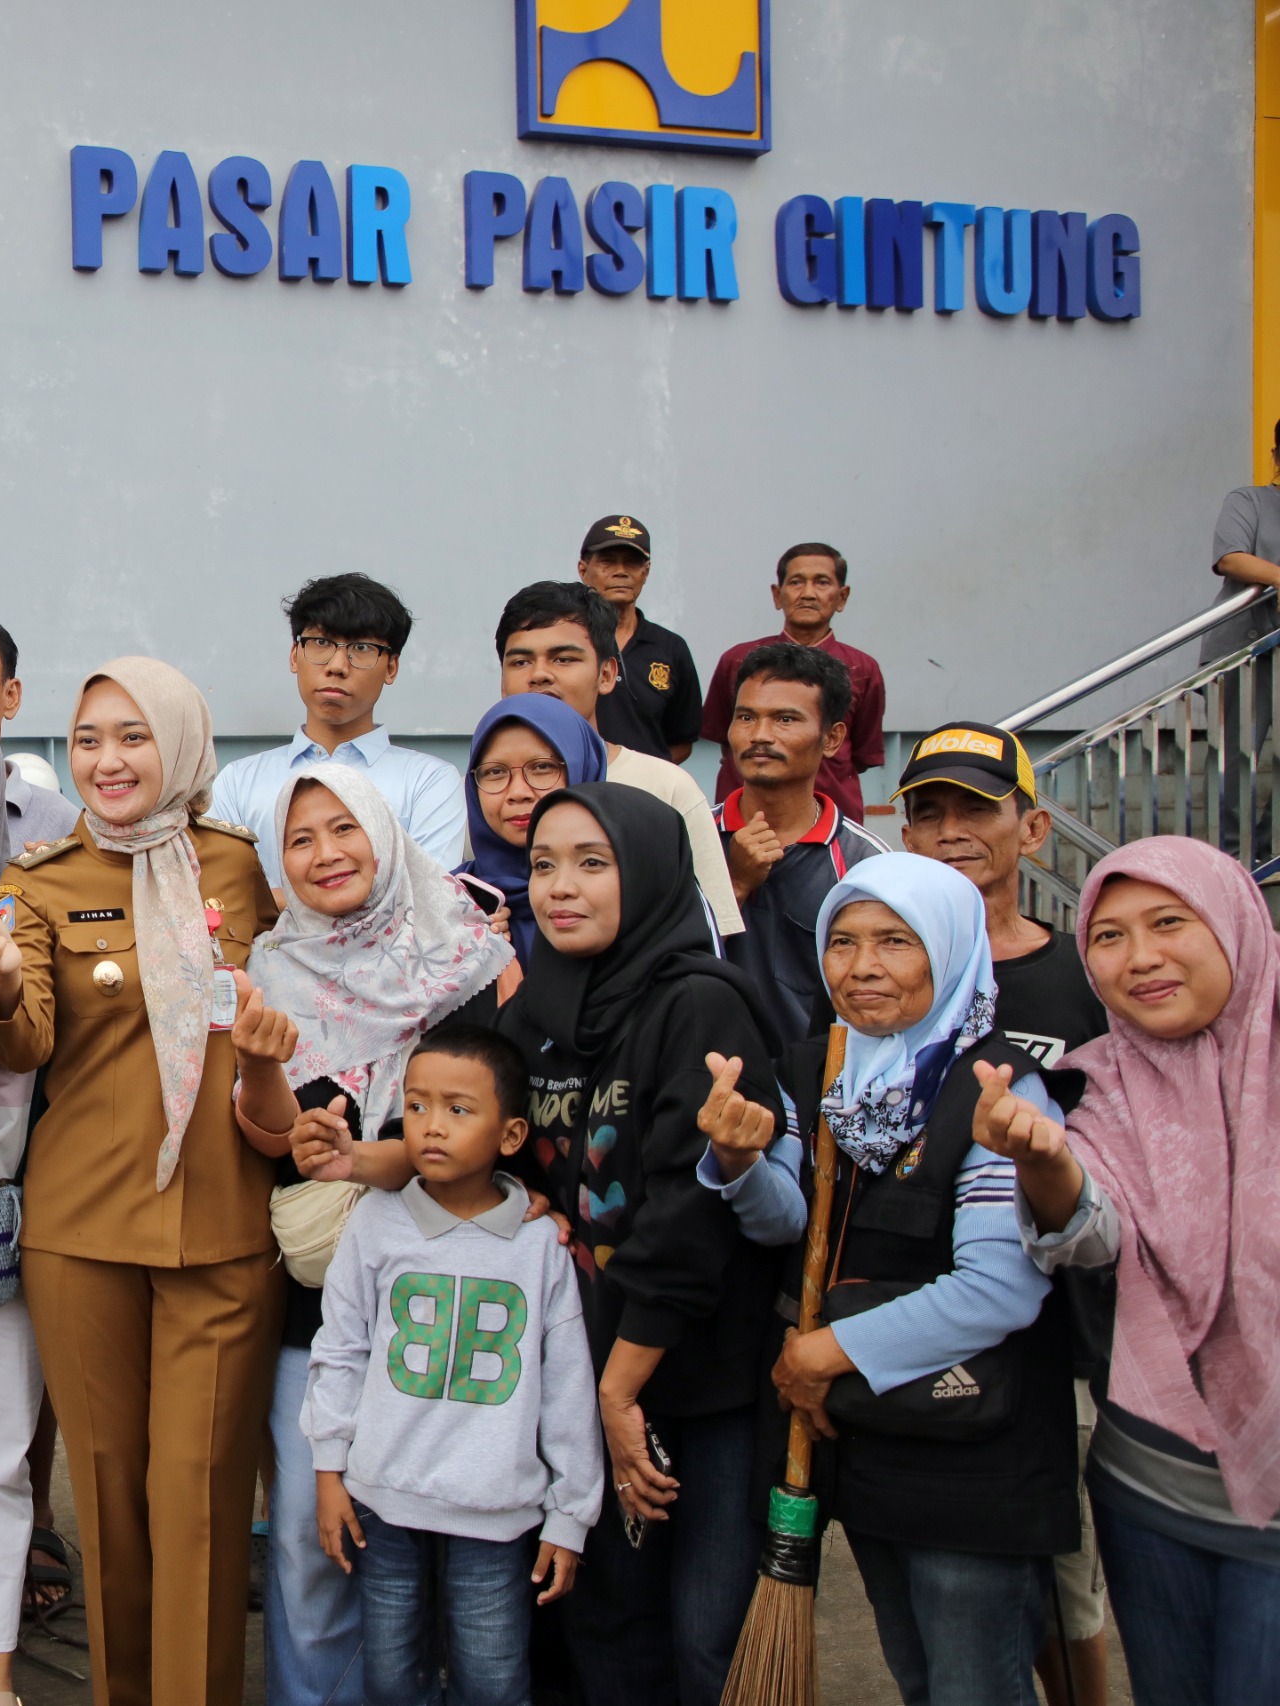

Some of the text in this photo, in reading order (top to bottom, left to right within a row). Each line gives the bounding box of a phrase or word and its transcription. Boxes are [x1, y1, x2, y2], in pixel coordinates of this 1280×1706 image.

[72, 145, 1142, 322] PASAR PASIR GINTUNG
[919, 731, 999, 757] Woles
[80, 911, 113, 919] JIHAN
[932, 1385, 980, 1399] adidas
